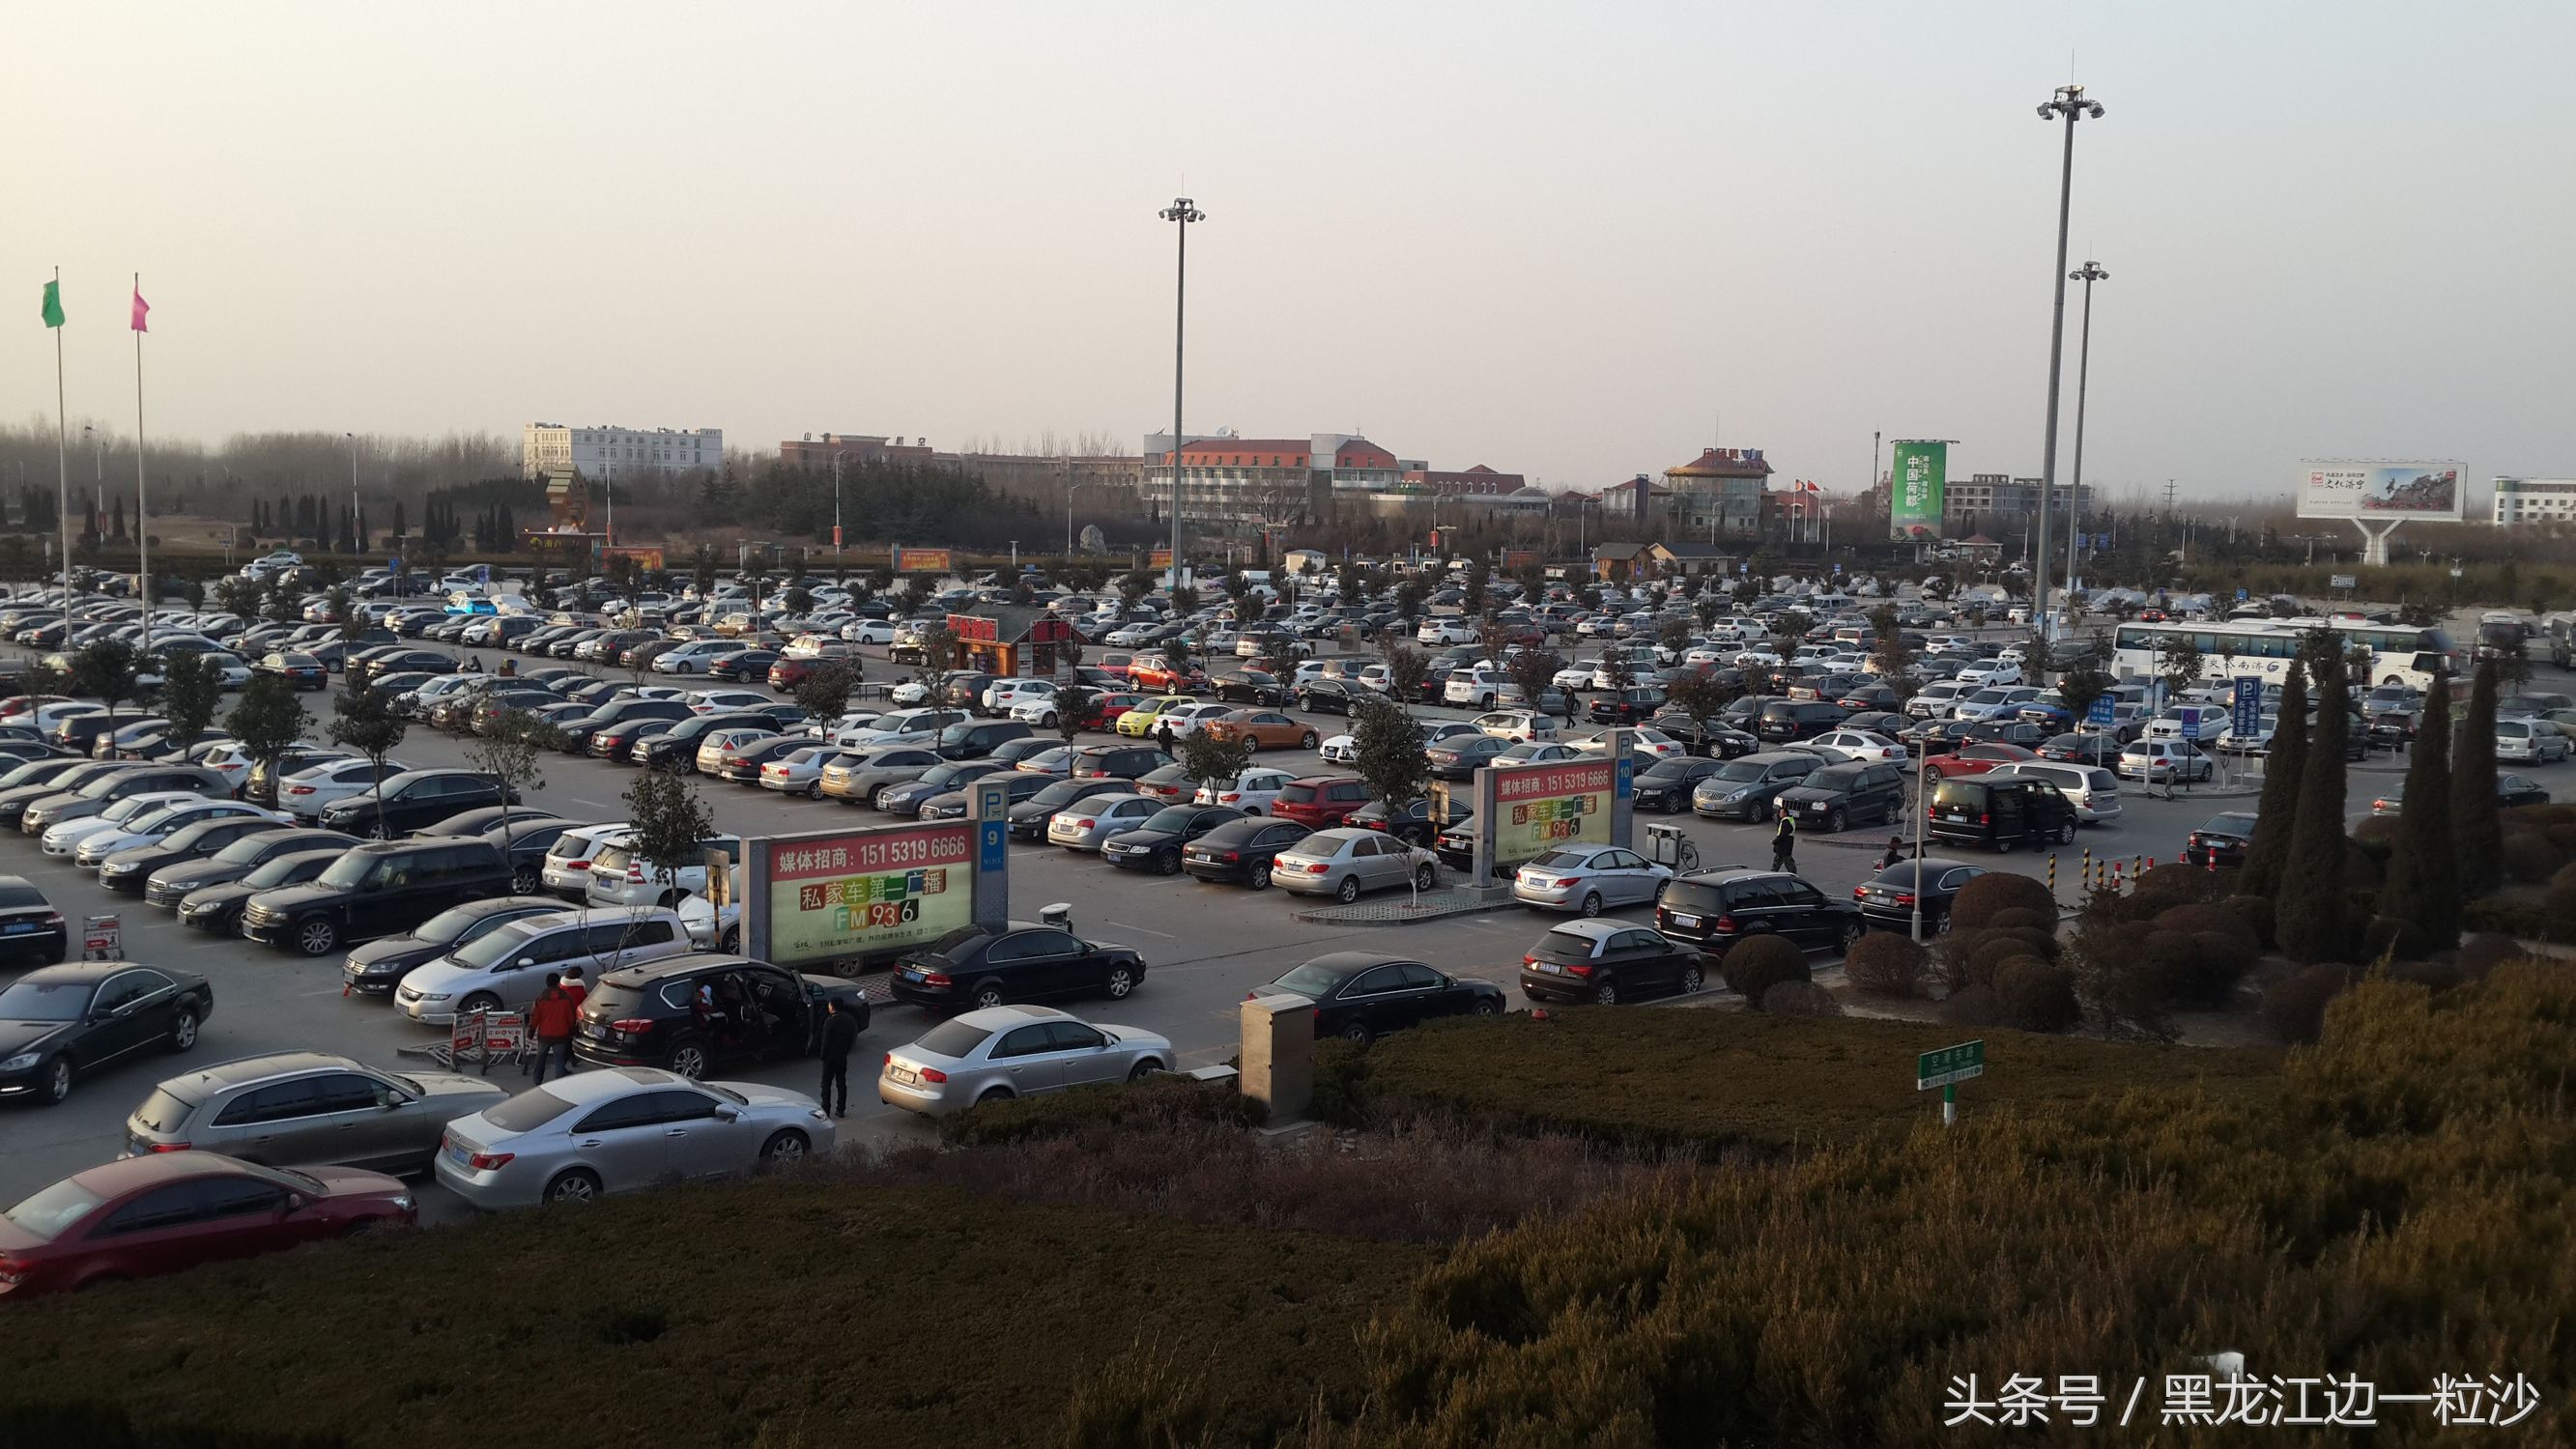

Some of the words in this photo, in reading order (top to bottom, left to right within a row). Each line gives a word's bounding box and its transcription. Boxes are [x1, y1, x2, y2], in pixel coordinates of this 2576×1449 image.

[1905, 456, 1919, 507] 中国荷都
[2238, 700, 2247, 734] 长途客车
[1502, 778, 1545, 796] 媒体招商：
[1548, 775, 1562, 791] 151
[1565, 772, 1585, 789] 5319
[1589, 770, 1608, 786] 6666
[1619, 766, 1630, 779] 10
[1513, 796, 1593, 824] 私家车第一广播
[987, 831, 998, 846] 9
[779, 847, 854, 873] 媒体招商：
[860, 842, 886, 866] 151
[891, 839, 927, 863] 5319
[931, 836, 965, 858] 6666
[983, 857, 1003, 866] NINE
[802, 871, 941, 911] 私家车第一广播
